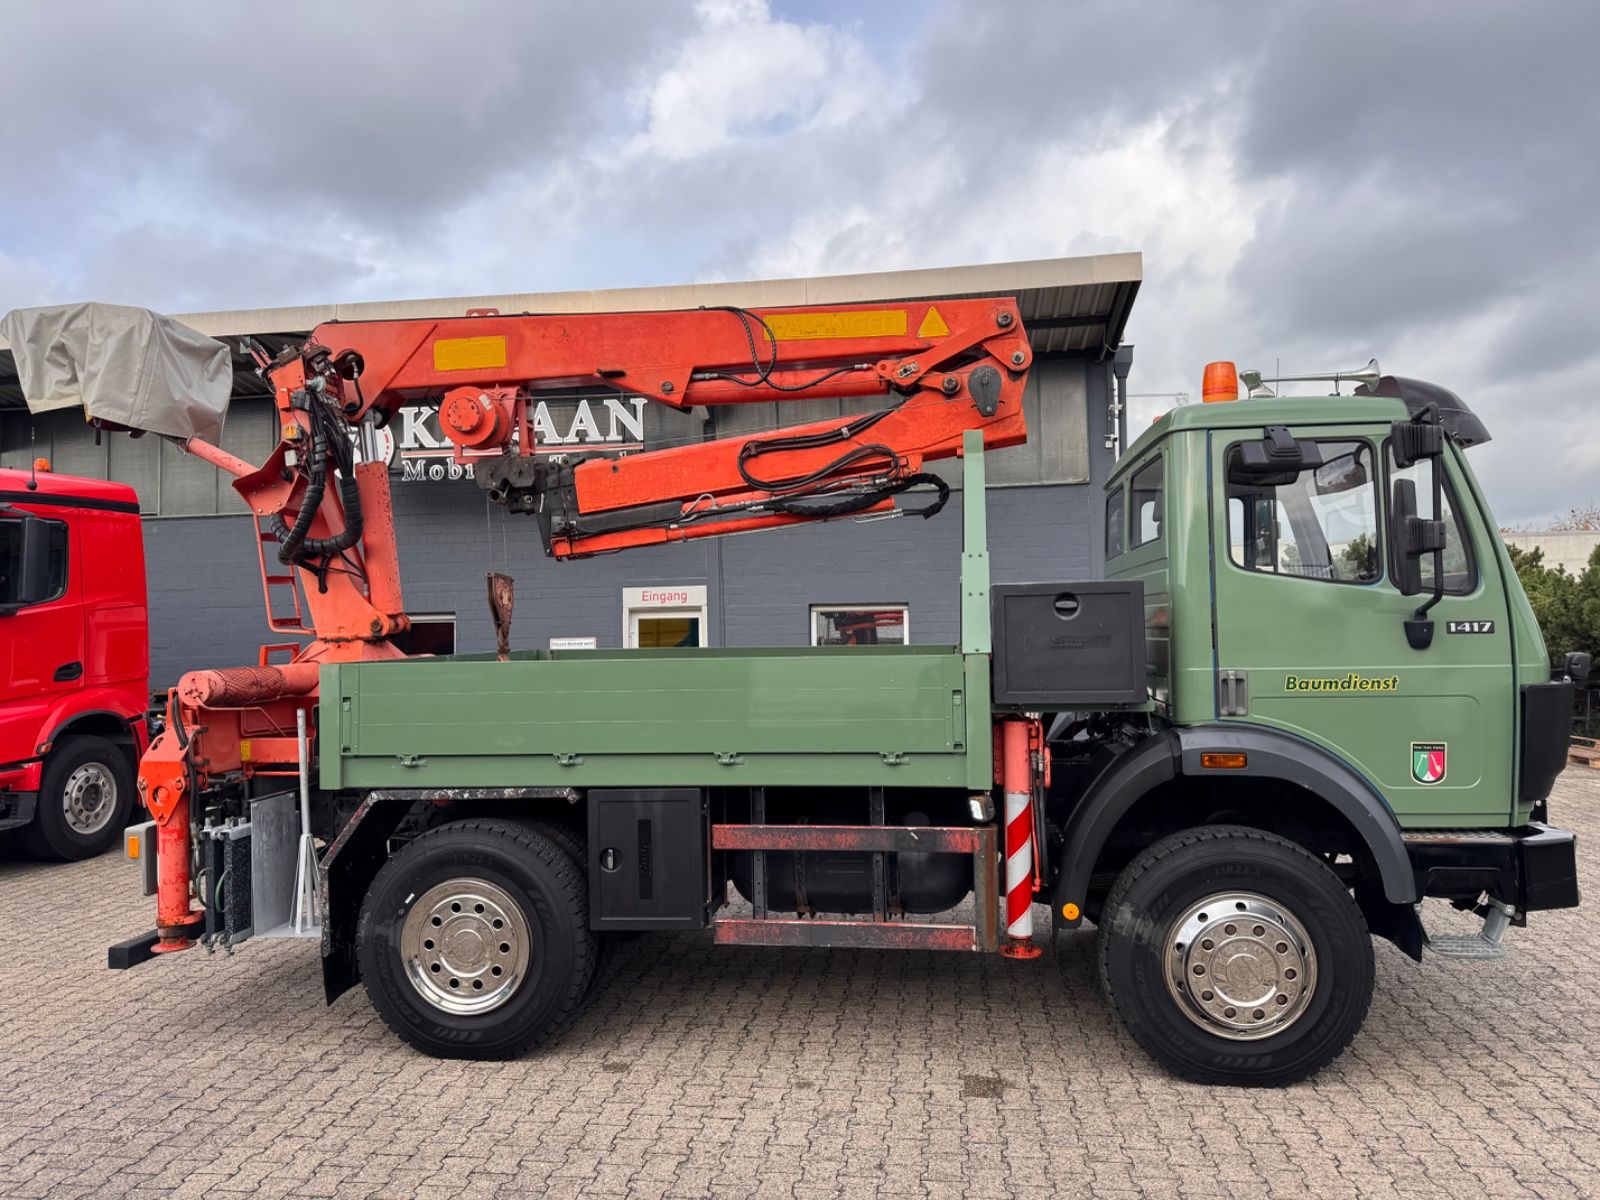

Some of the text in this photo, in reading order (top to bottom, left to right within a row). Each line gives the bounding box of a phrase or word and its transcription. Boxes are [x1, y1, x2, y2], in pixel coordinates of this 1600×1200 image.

[641, 590, 688, 604] Eingang
[1449, 622, 1493, 633] 1417
[1284, 673, 1400, 691] Baumdienst
